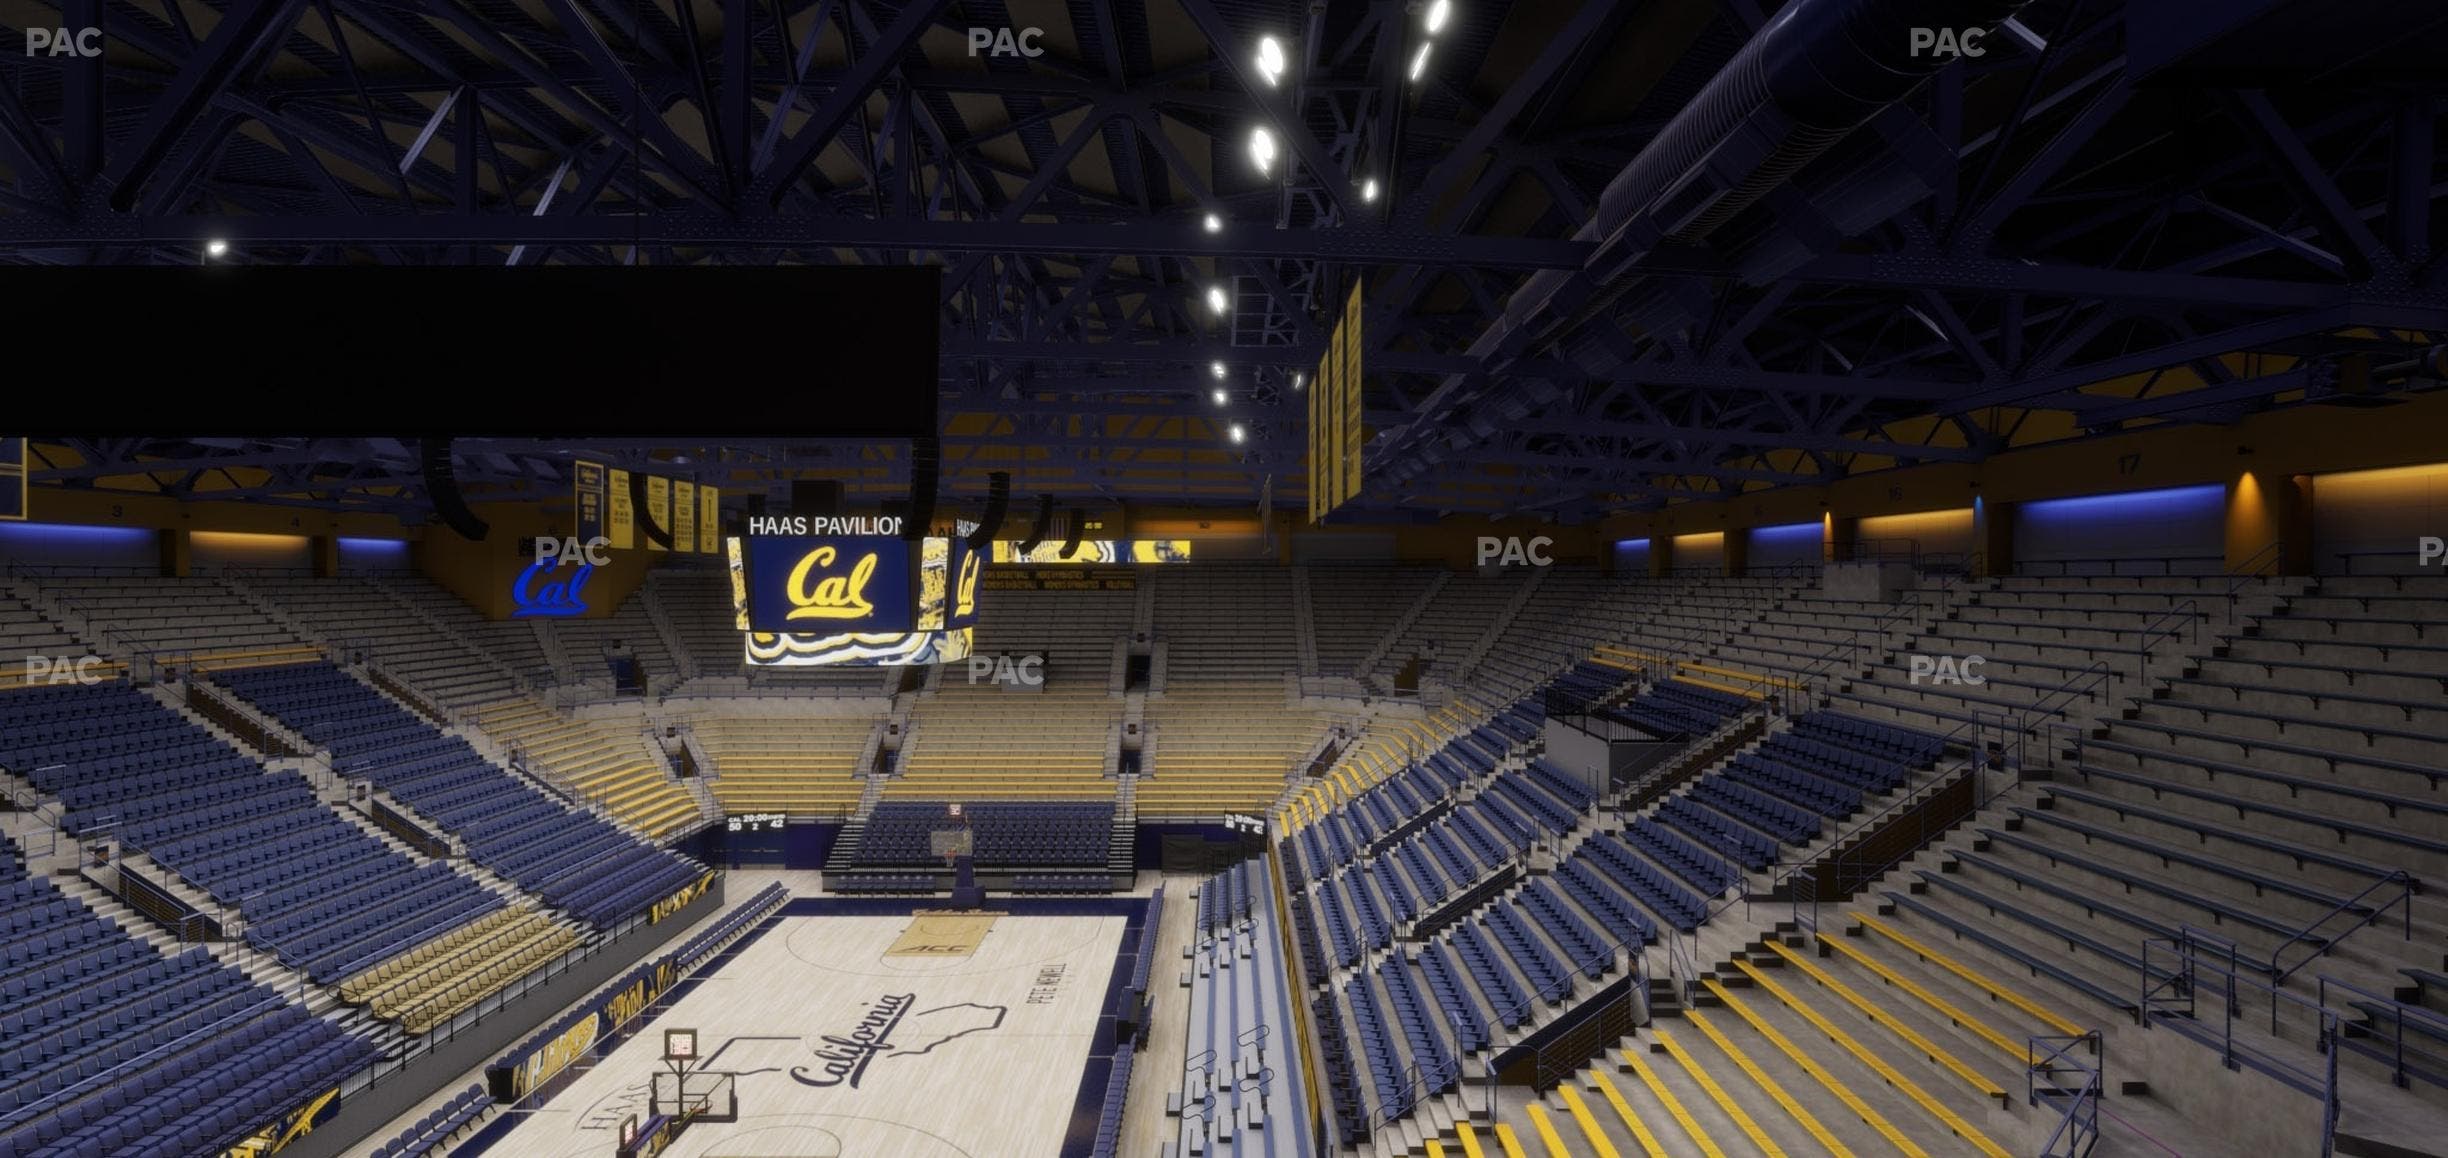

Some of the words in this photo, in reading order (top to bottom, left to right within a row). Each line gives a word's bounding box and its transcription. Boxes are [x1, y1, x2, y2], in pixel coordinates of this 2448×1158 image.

[2118, 453, 2140, 474] 17
[749, 517, 807, 536] HAAS
[511, 556, 594, 618] Cal
[785, 546, 878, 620] Cal
[955, 549, 980, 618] Cal
[728, 823, 742, 831] 50
[752, 823, 759, 831] 2
[770, 820, 784, 828] 42
[743, 814, 768, 822] 20:00
[895, 944, 970, 954] ACC
[1032, 963, 1067, 986] NEWELL
[1025, 987, 1057, 1004] PETE
[790, 992, 917, 1090] California
[580, 1079, 653, 1130] HAAS
